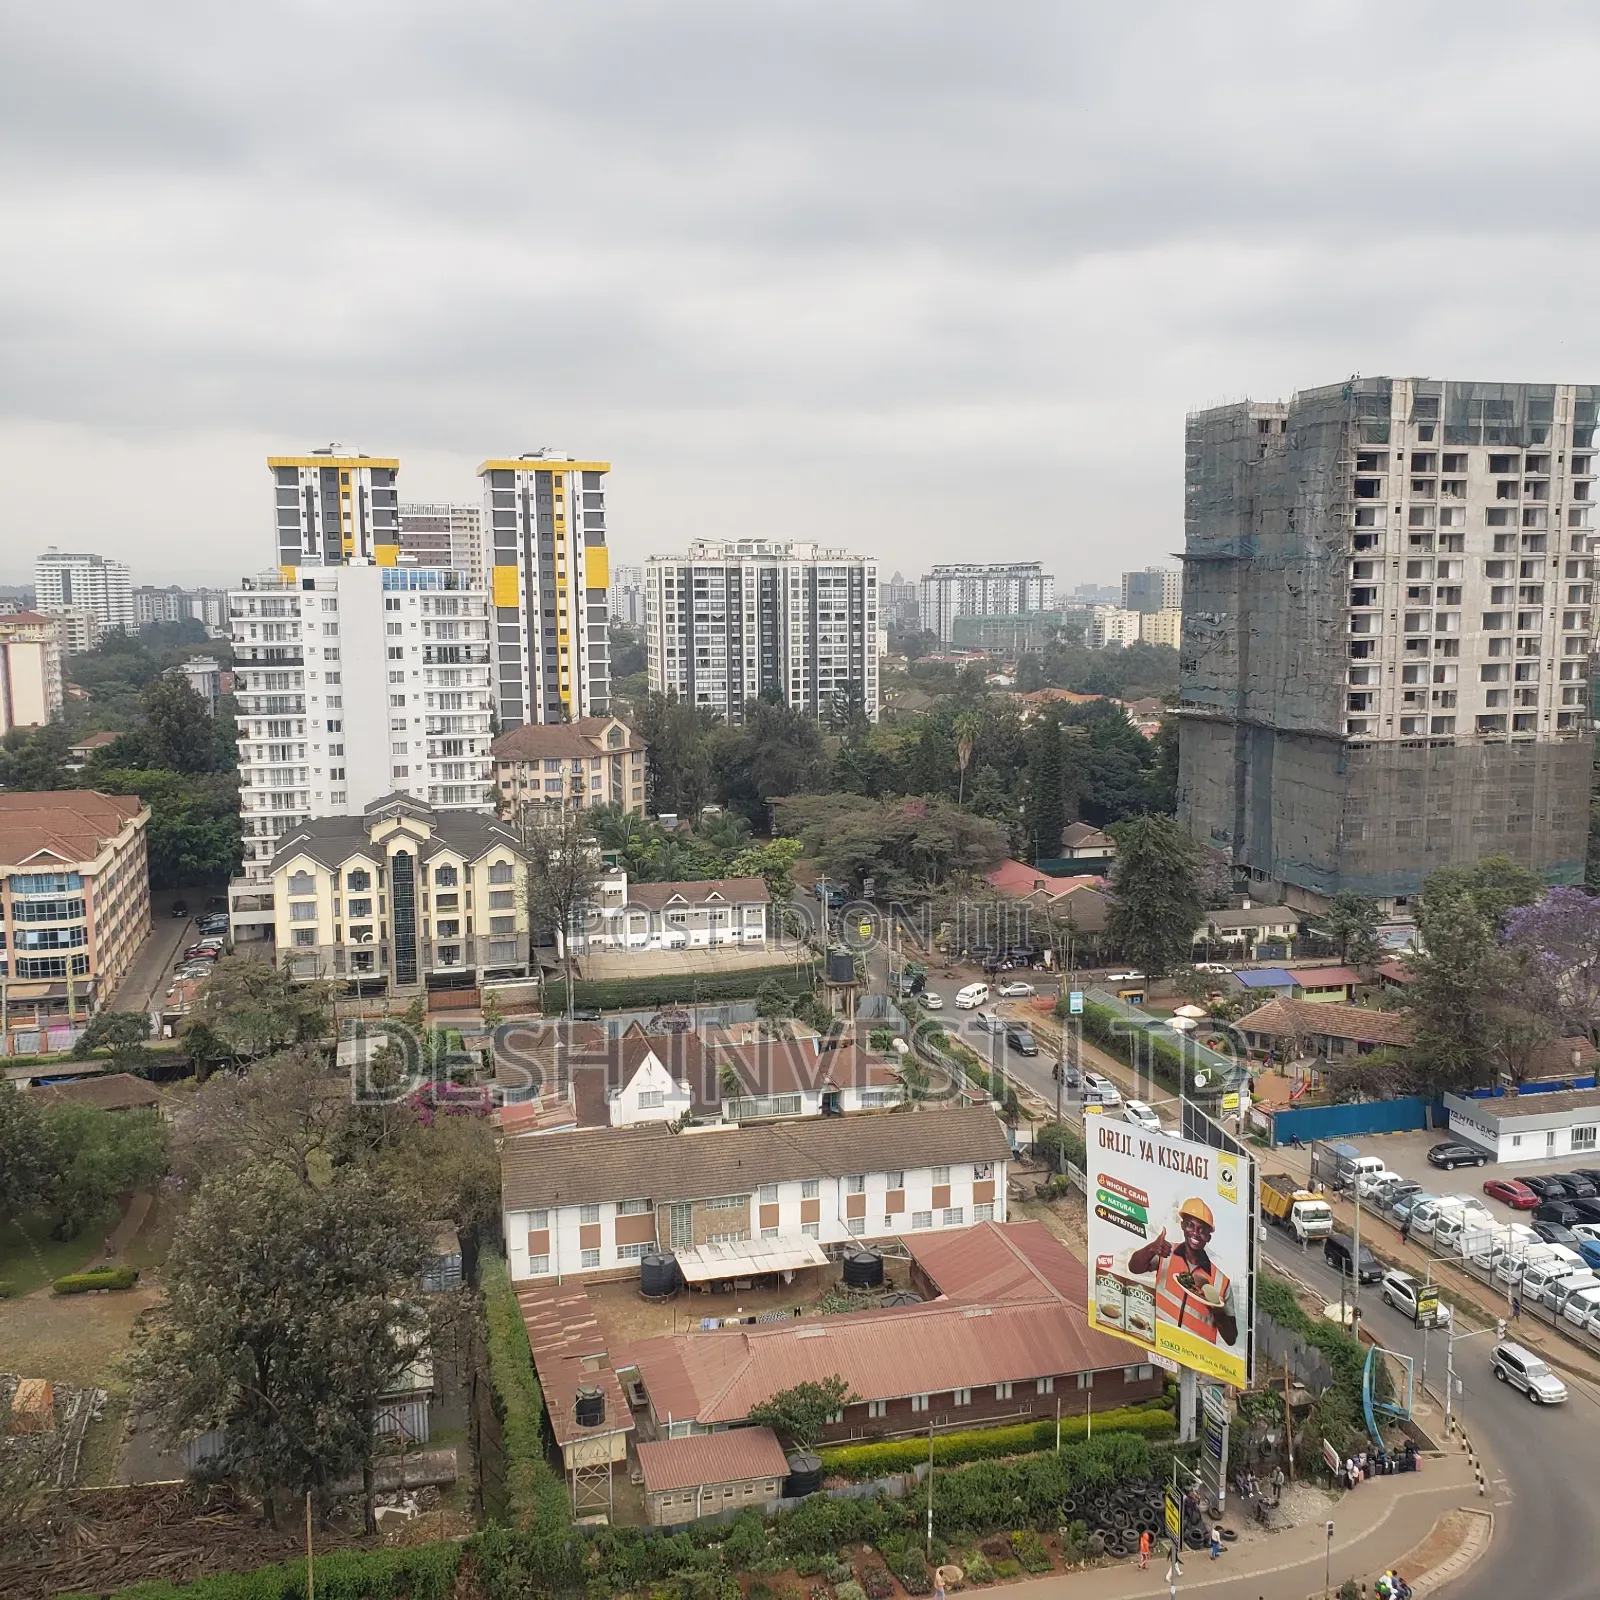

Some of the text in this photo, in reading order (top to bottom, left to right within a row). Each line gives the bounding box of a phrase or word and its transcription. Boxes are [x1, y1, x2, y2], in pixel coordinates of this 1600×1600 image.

[1098, 1127, 1209, 1180] ORIJI. YA KISIAGI
[1105, 1179, 1148, 1204] WHOLE GRAIN
[1107, 1196, 1136, 1215] NATURAL
[1107, 1212, 1145, 1235] NUTRITIOUS
[1097, 1256, 1113, 1266] NEW
[1100, 1277, 1121, 1292] SOKO
[1129, 1288, 1152, 1304] SOKO
[1160, 1338, 1180, 1352] SOKO
